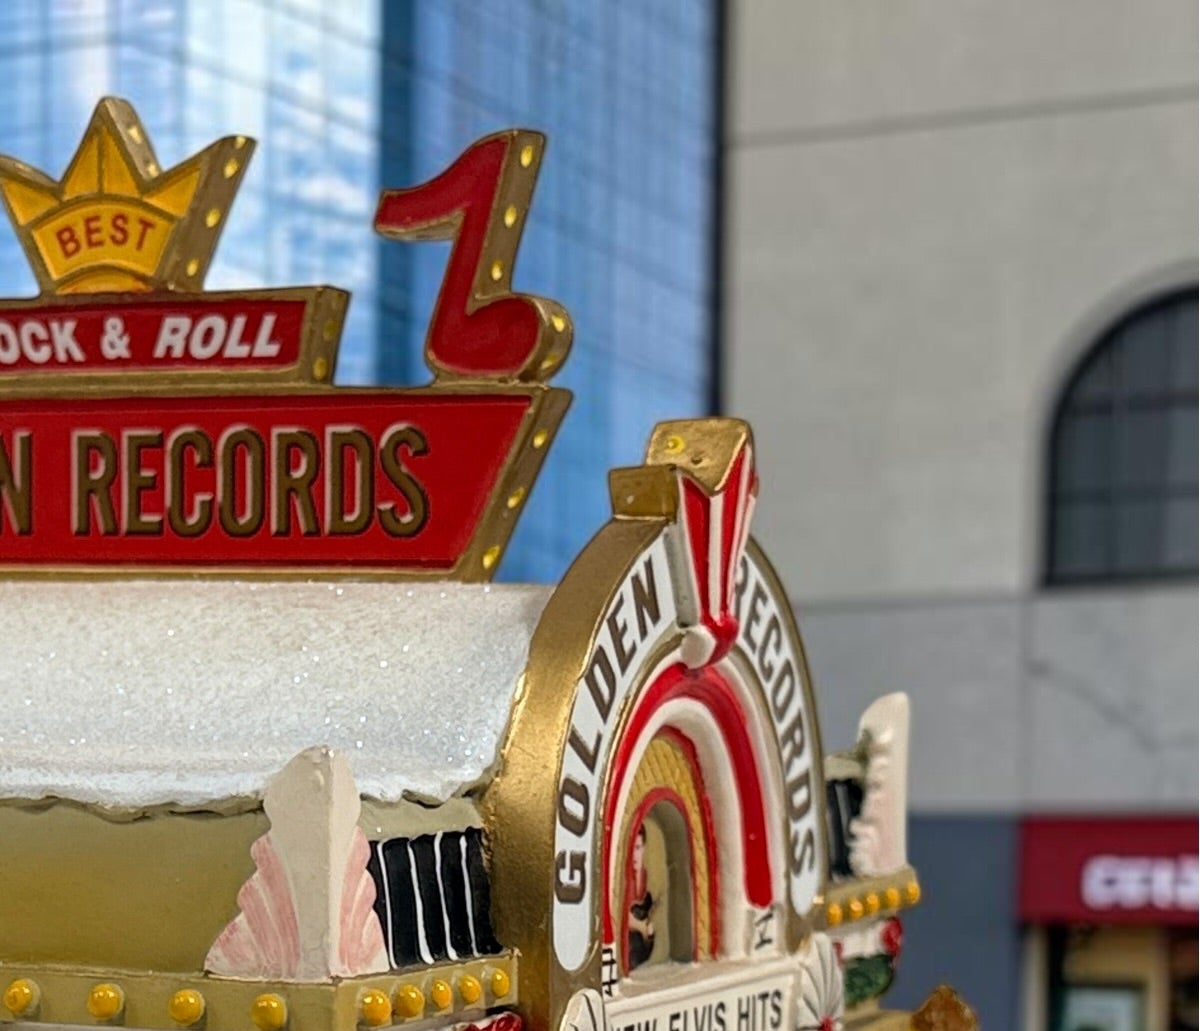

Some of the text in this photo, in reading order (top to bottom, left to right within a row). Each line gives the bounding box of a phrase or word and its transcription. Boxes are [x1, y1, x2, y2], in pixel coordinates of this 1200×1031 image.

[55, 213, 156, 260] BEST
[101, 316, 131, 360] &
[153, 313, 282, 359] ROLL
[75, 423, 431, 537] RECORDS
[554, 555, 662, 905] GOLDEN
